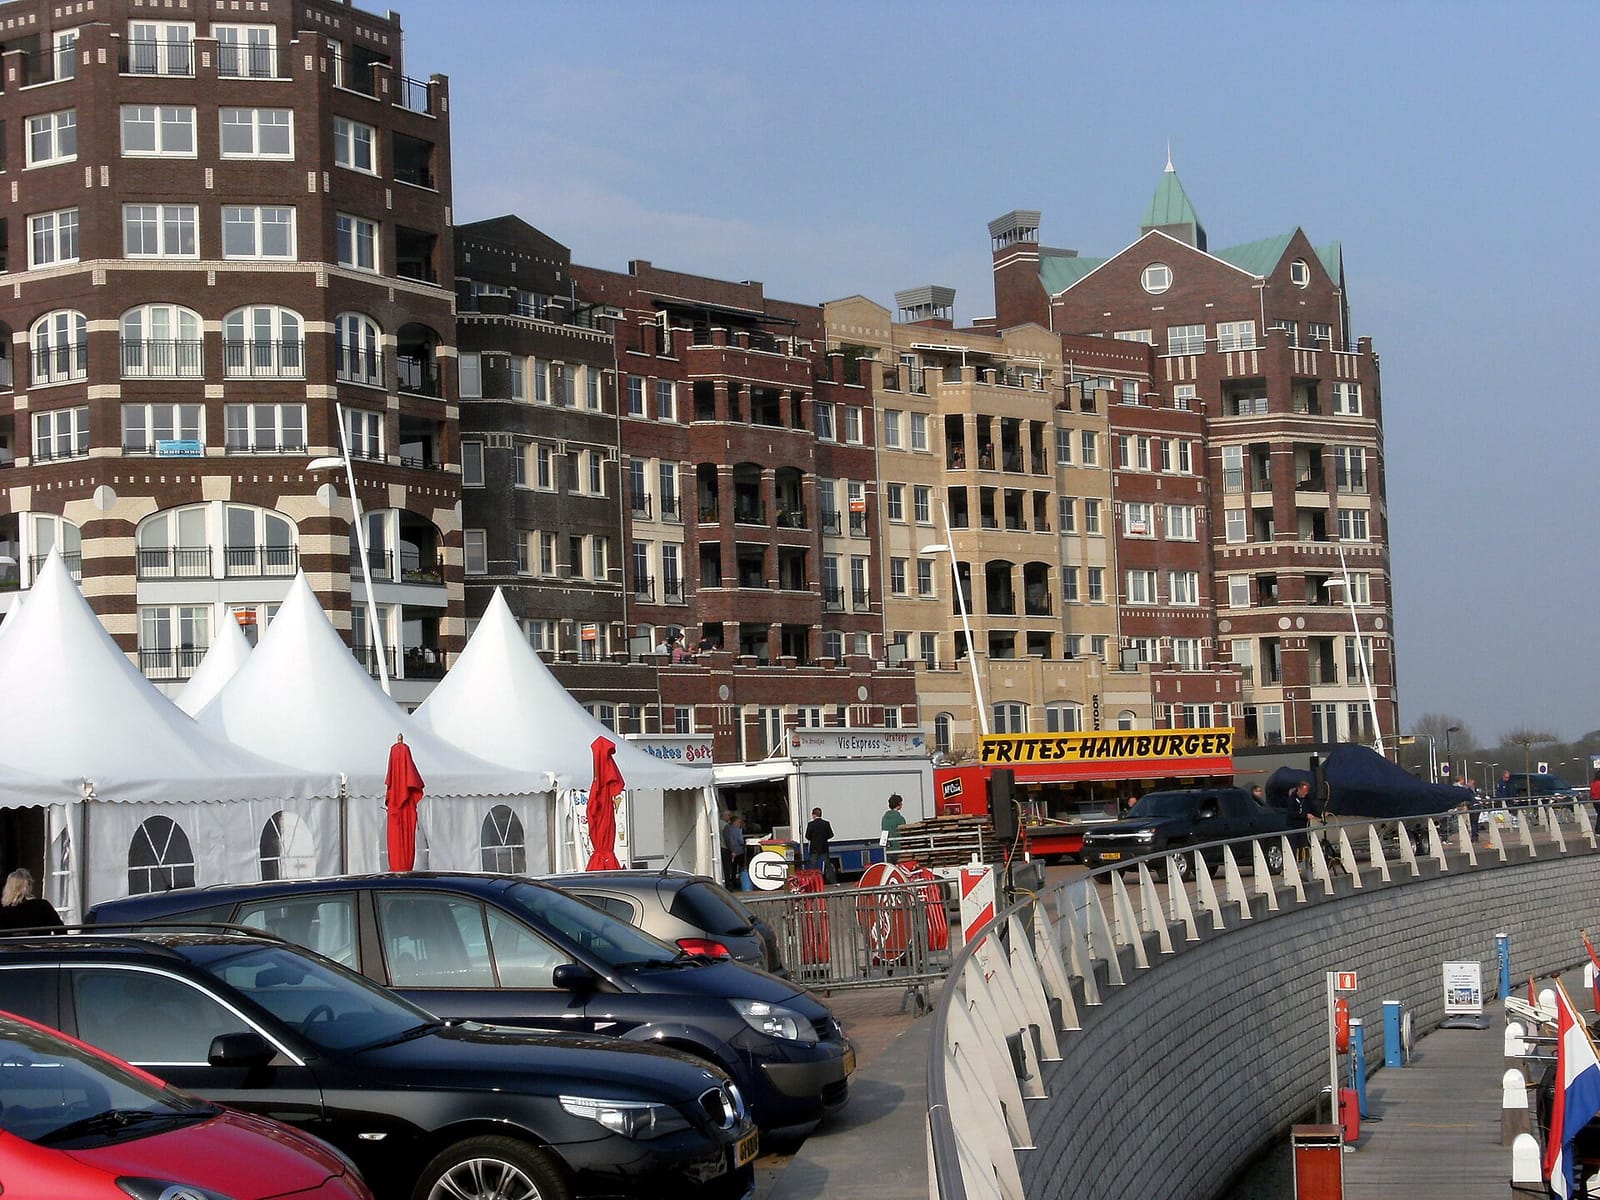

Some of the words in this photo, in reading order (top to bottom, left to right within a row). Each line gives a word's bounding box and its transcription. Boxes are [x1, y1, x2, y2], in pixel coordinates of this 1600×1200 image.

[642, 744, 682, 759] hakes
[837, 736, 850, 749] Vis
[851, 736, 881, 752] Express
[981, 734, 1230, 762] FRITES-HAMBURGER
